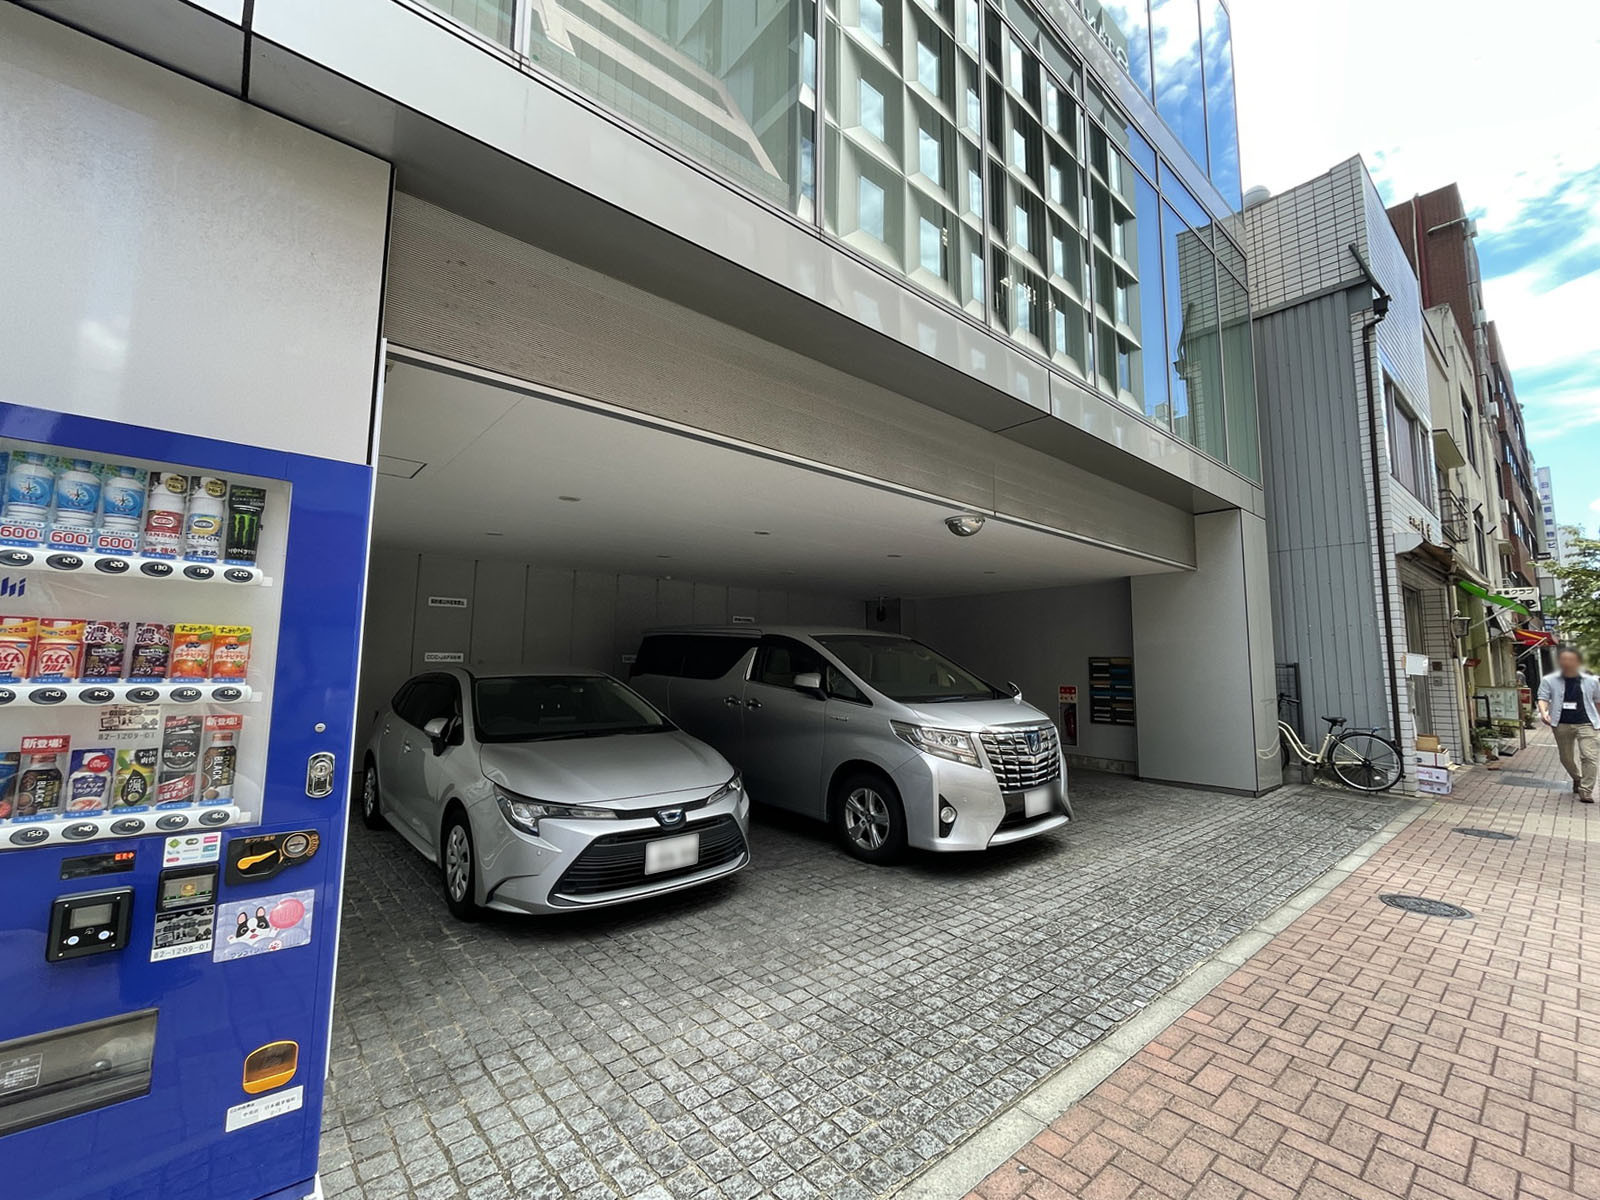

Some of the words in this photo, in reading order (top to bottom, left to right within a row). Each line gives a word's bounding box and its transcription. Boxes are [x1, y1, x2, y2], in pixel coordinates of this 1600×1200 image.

[0, 526, 38, 539] 600
[51, 531, 88, 545] 600
[98, 536, 133, 549] 600
[212, 756, 224, 780] BLACK
[34, 780, 47, 803] BLACK
